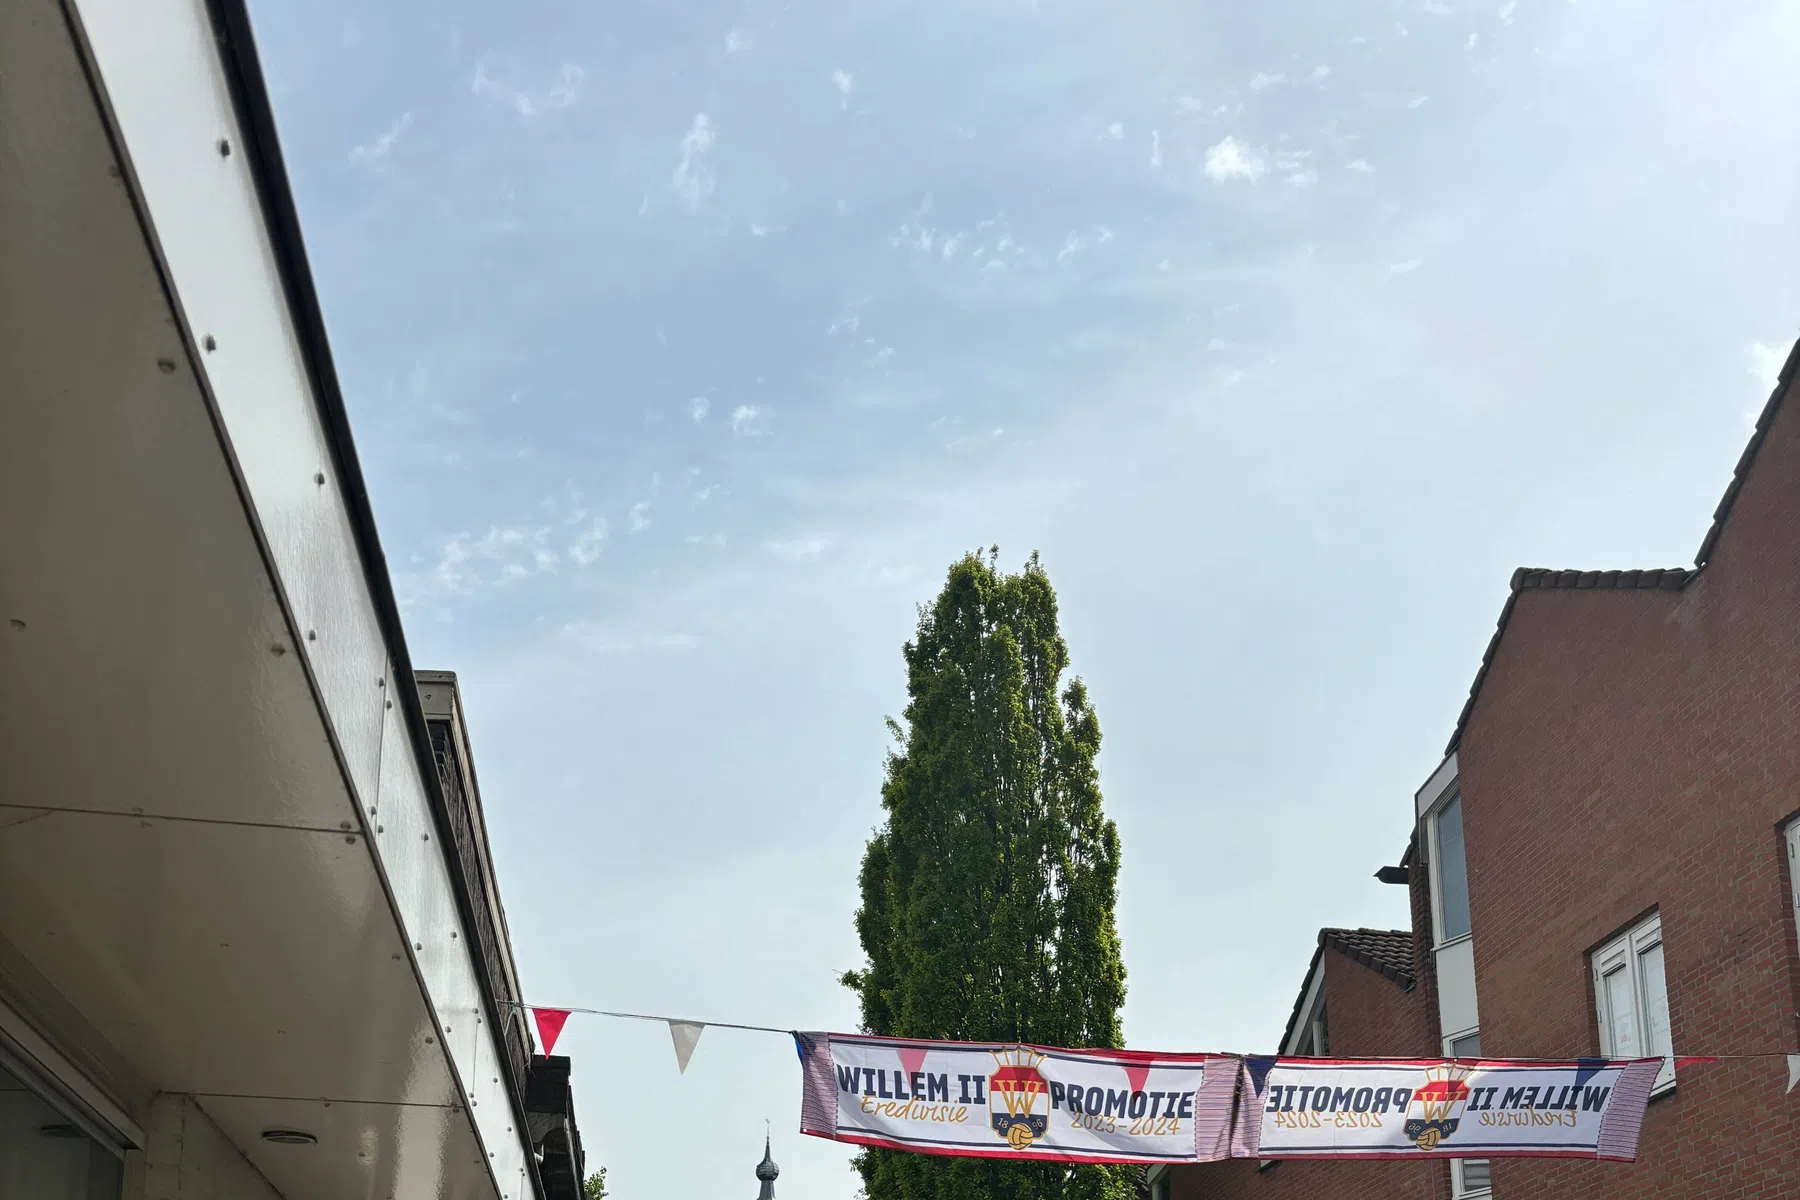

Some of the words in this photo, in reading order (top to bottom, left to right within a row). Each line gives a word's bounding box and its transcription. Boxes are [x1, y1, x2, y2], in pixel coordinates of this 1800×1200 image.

[836, 1064, 949, 1104] WILLEM
[958, 1074, 986, 1105] II
[1049, 1081, 1193, 1119] PROMOTIE
[861, 1094, 969, 1124] Eredivisie
[1070, 1110, 1181, 1136] 2023-2024
